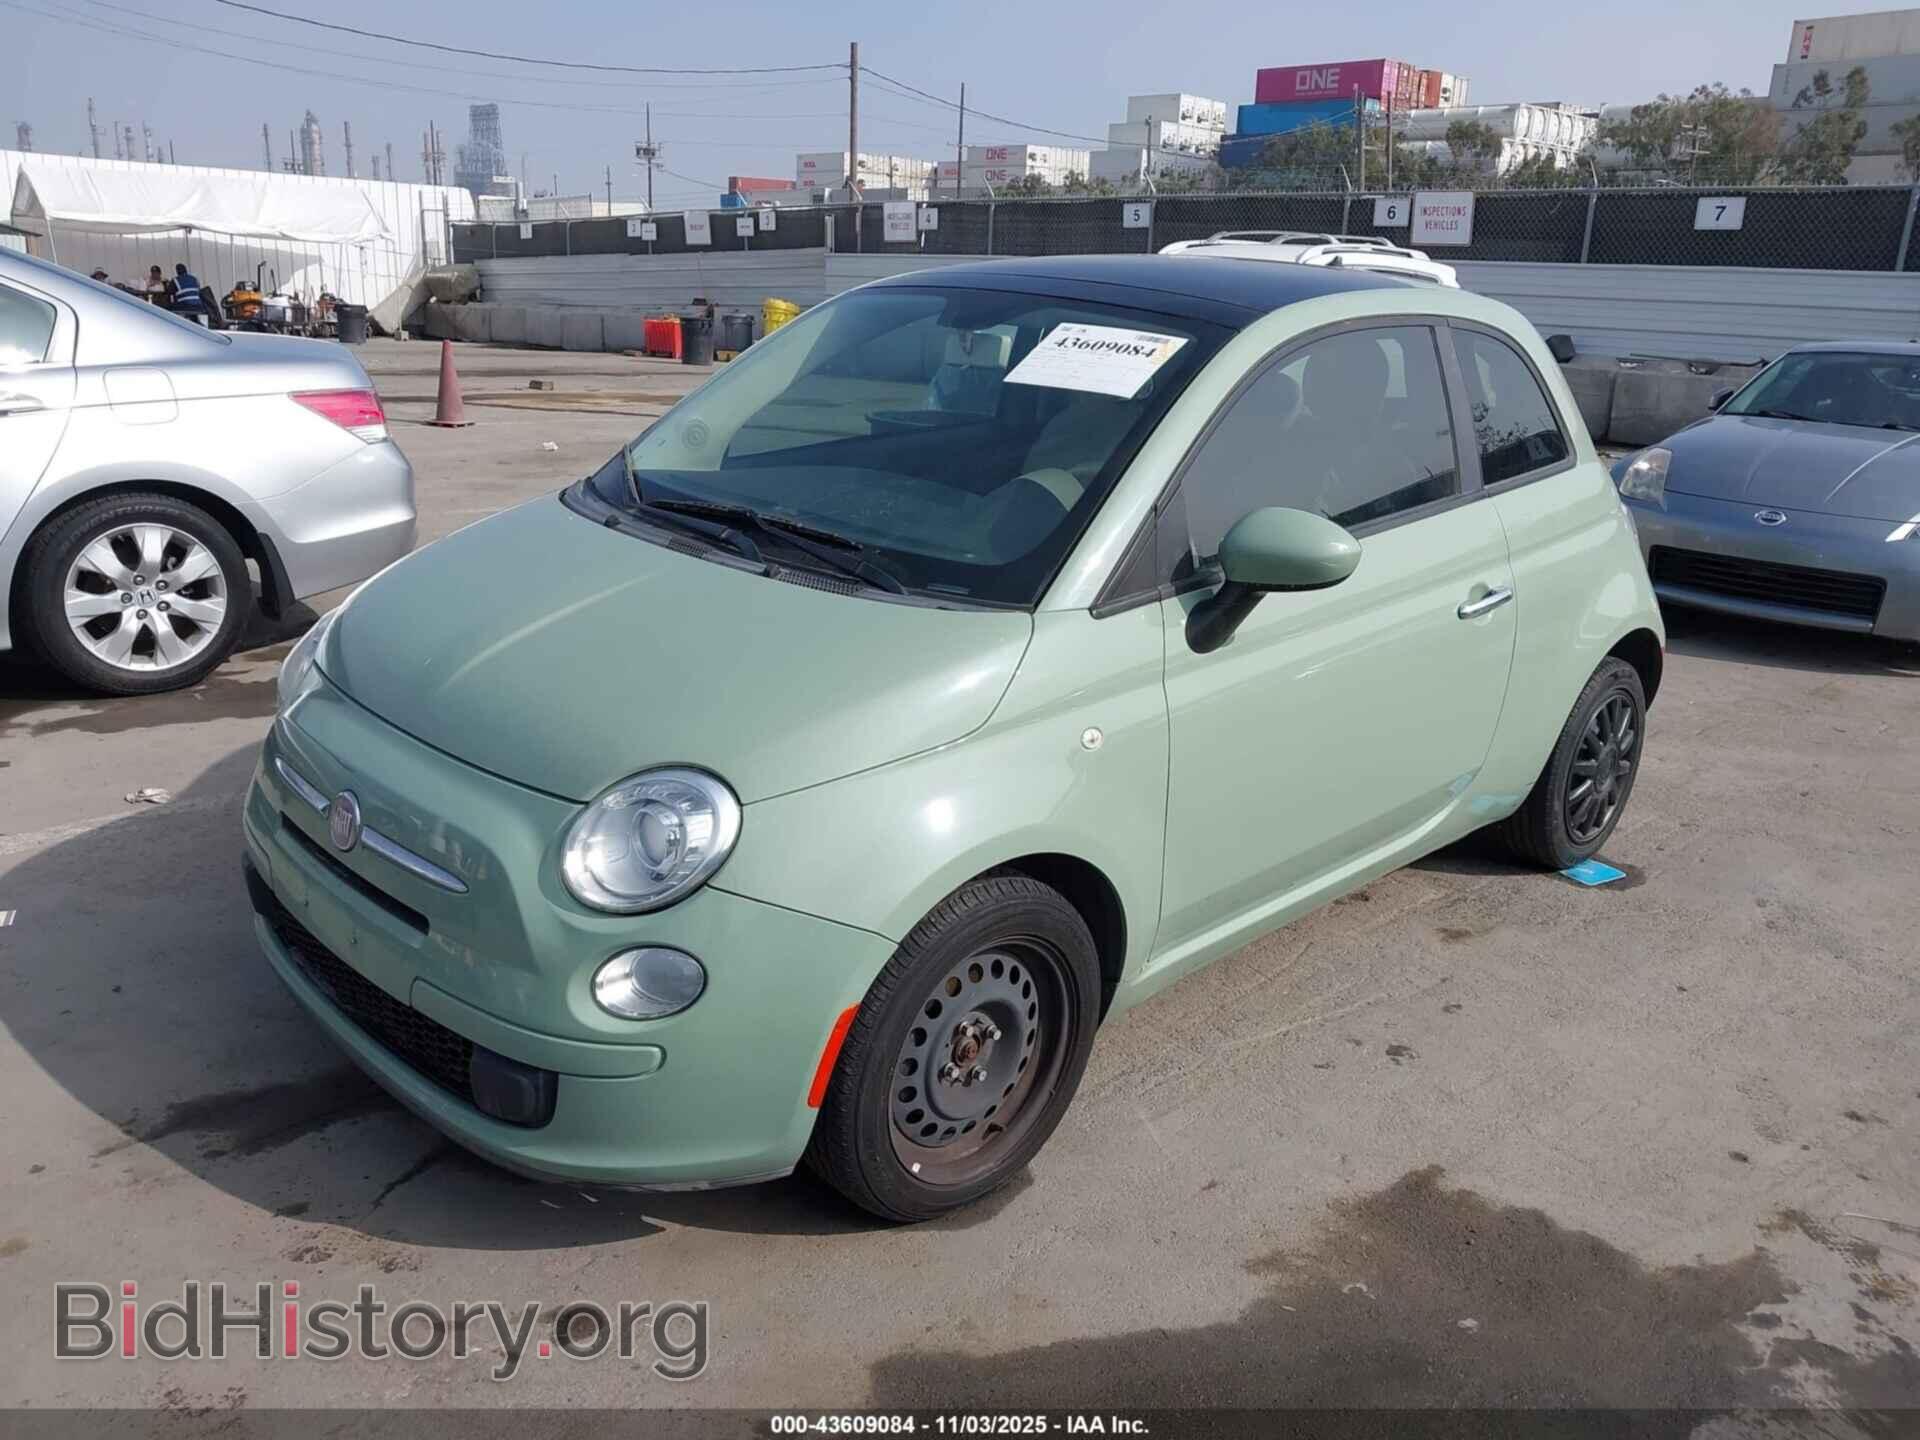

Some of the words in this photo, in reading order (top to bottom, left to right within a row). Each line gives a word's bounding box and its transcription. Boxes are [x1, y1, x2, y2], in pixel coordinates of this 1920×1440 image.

[1296, 68, 1340, 90] ONE
[986, 148, 1008, 160] ONE
[1134, 209, 1141, 222] 5
[1387, 205, 1397, 220] 6
[1420, 206, 1467, 217] INSPECTIONS
[1715, 205, 1727, 221] 7
[1424, 220, 1459, 231] VEHICLES
[1054, 336, 1157, 358] 43609084
